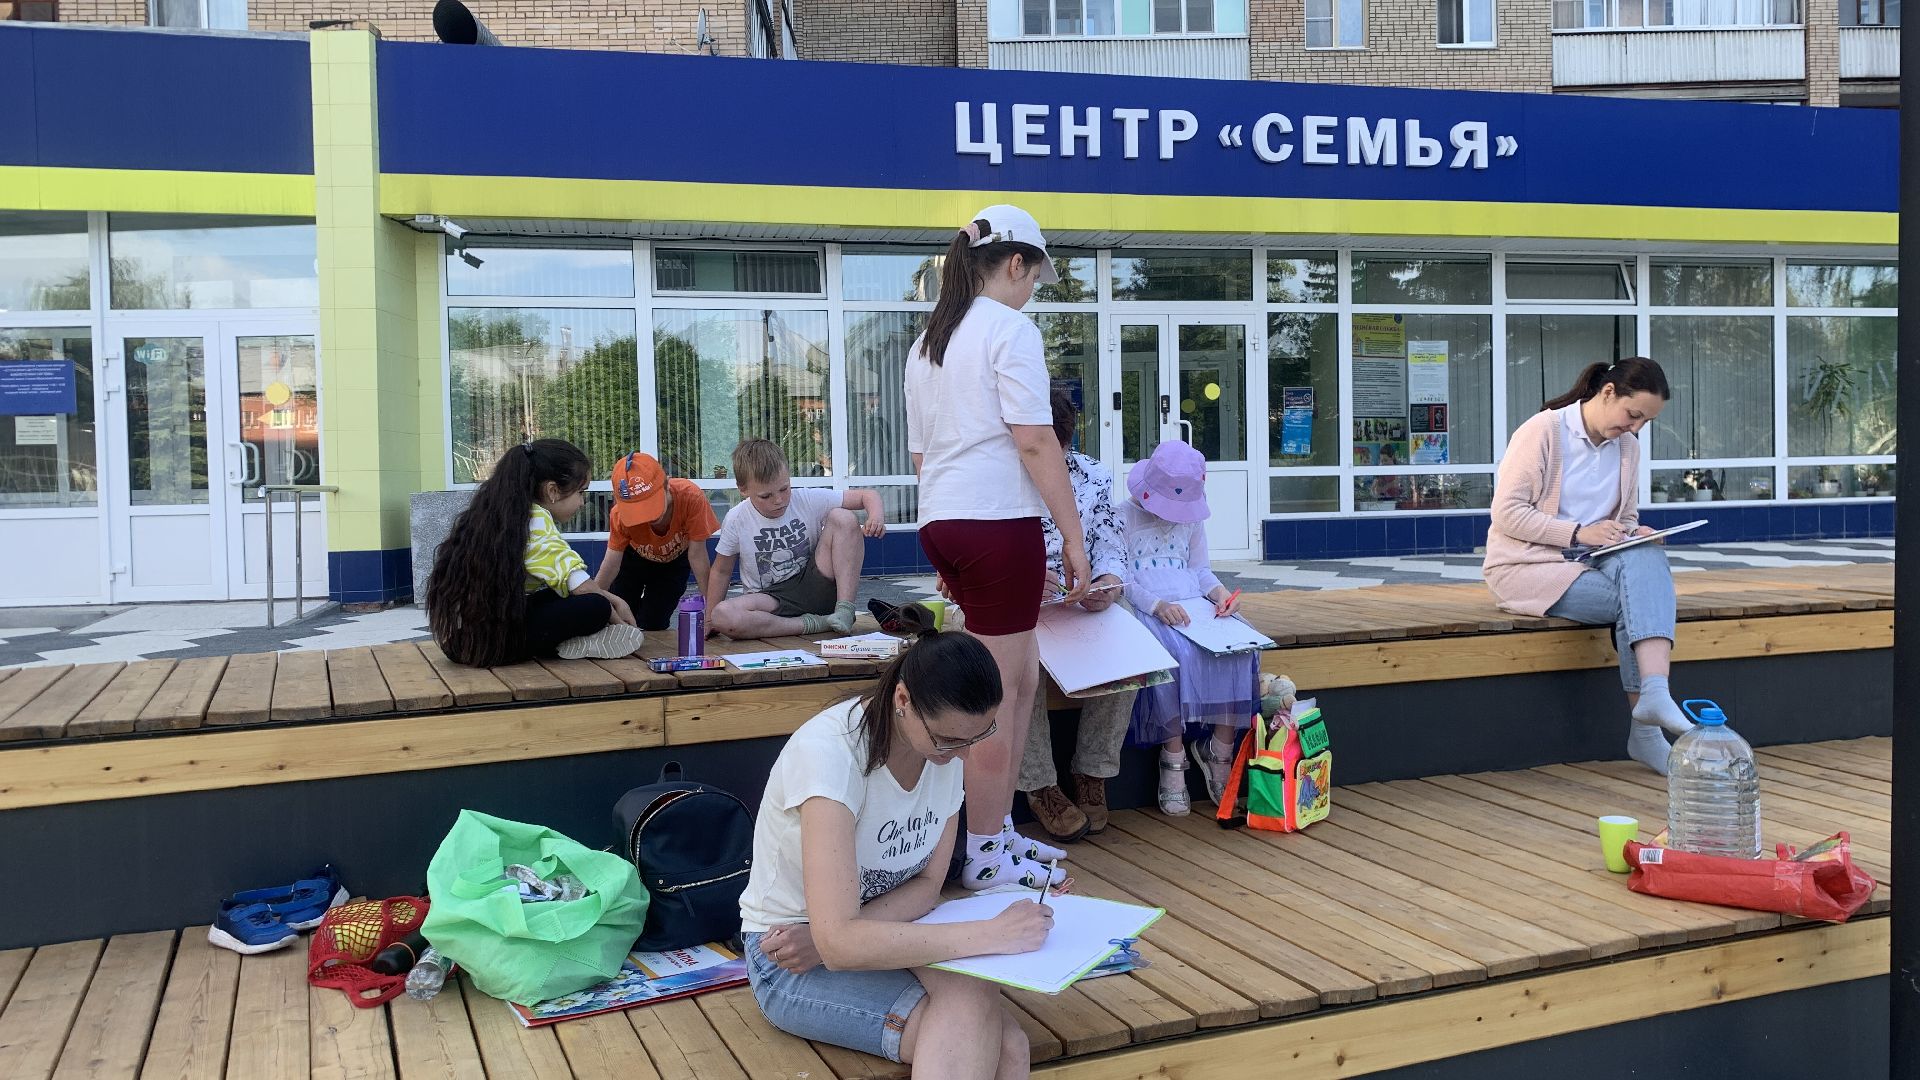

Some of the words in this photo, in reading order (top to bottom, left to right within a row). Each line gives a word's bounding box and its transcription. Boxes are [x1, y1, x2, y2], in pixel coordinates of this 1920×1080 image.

[955, 101, 1199, 165] ЦЕНТР
[1218, 111, 1519, 169] «СЕМЬЯ»
[753, 518, 806, 540] STAR
[754, 526, 807, 552] WARS
